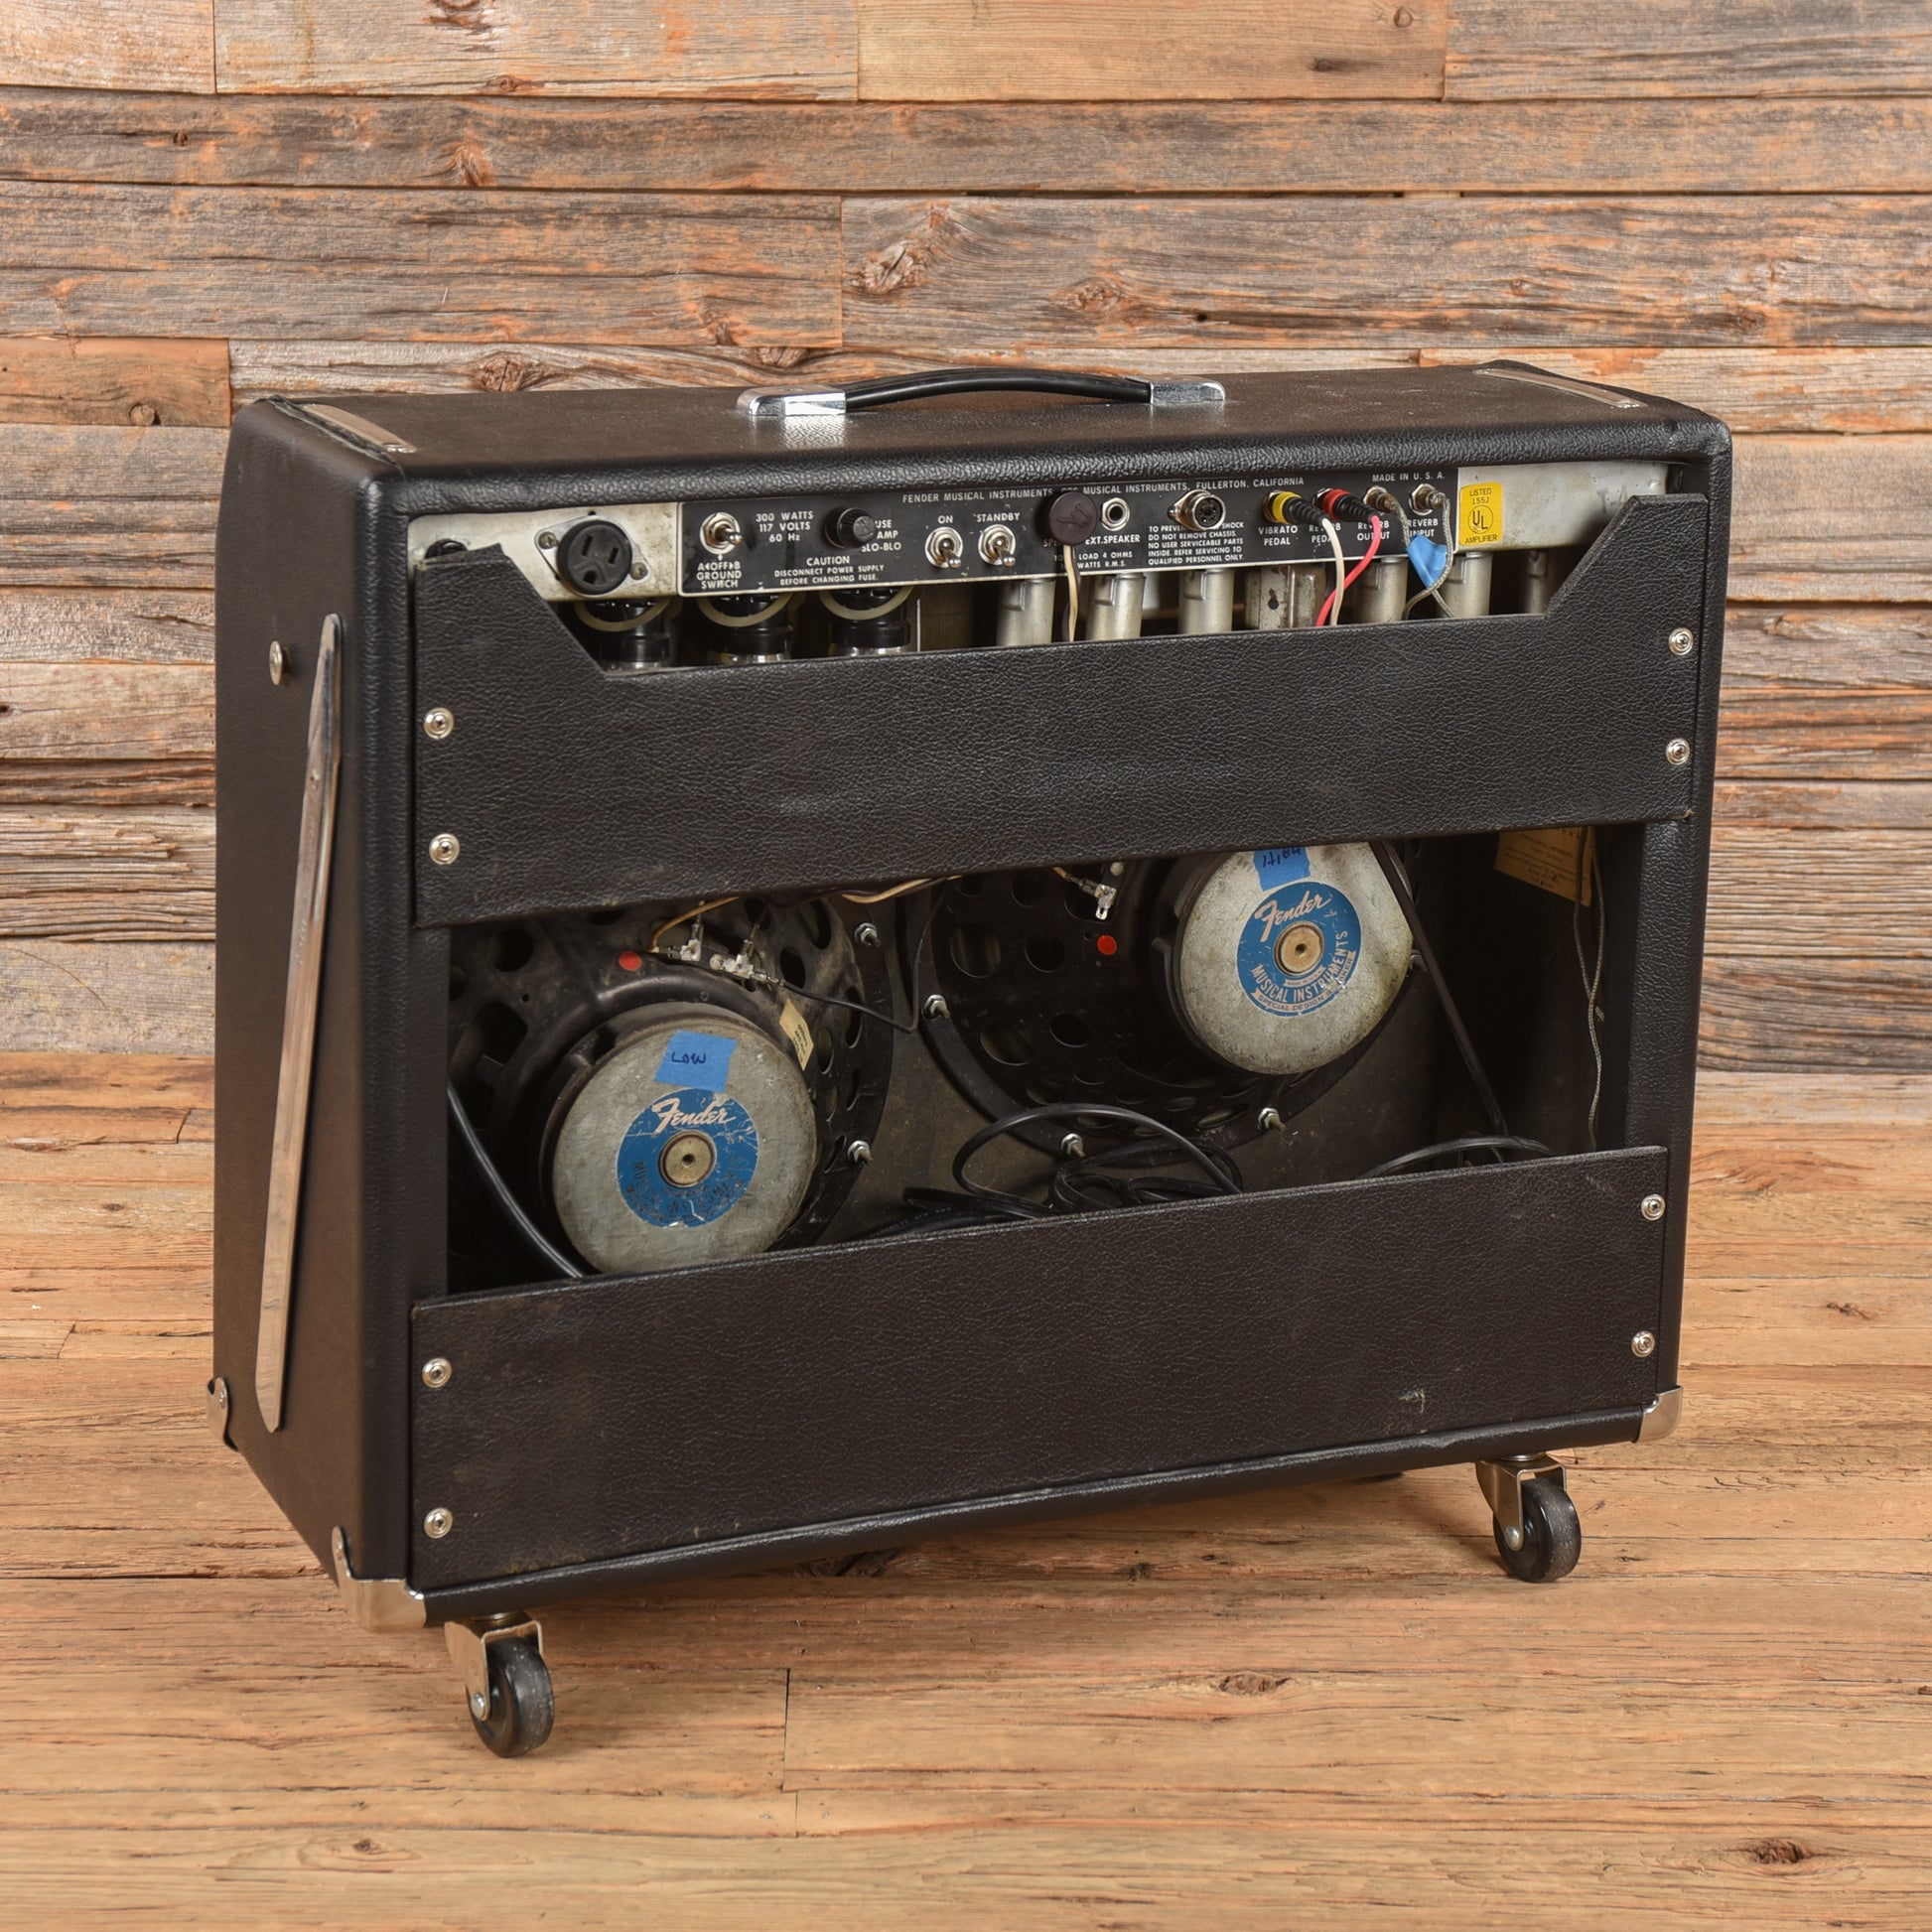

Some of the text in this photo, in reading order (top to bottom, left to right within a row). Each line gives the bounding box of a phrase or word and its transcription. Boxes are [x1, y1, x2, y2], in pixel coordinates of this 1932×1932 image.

[1372, 474, 1395, 483] MADE
[1083, 484, 1122, 494] MUSICAL
[1253, 477, 1305, 487] CALIFORNIA
[902, 494, 939, 503] FENDER
[943, 492, 985, 501] MUSICAL
[989, 488, 1053, 499] INSTRUMENTS
[1469, 487, 1492, 496] LISTED
[756, 511, 814, 522] 300 WATTS
[937, 514, 953, 524] ON
[976, 512, 1021, 523] STANDBY
[1408, 517, 1439, 527] REVERB
[759, 521, 811, 532] 117 VOLTS
[875, 519, 892, 529] USE
[1258, 524, 1299, 535] VIBRATO
[768, 532, 800, 543] 60 Hz
[877, 530, 898, 539] AMP
[1356, 531, 1390, 541] OUTUT
[1464, 534, 1498, 544] AMPLIFIER
[1180, 539, 1221, 548] SERVICEABLE
[1263, 536, 1291, 546] PEDAL
[1079, 551, 1099, 560] LOAD
[1111, 550, 1133, 559] OHMS
[1148, 557, 1182, 566] QUALIFIED
[1185, 555, 1222, 564] PERSONNEL
[806, 555, 850, 567] CAUTION
[1077, 560, 1101, 569] WATTS
[696, 570, 743, 581] GROUND
[774, 568, 823, 578] DISCONNECT
[858, 564, 885, 573] SUPPLY
[701, 579, 739, 589] SWITCH
[779, 576, 809, 586] BEFORE
[812, 574, 855, 584] CHANGING
[1254, 891, 1333, 943] Fender
[1251, 963, 1289, 1003] MUSICAL
[1293, 930, 1348, 1004] INSTRUMENTS
[1257, 995, 1291, 1012] SPECIAL
[1293, 994, 1324, 1012] DESIGN
[671, 1052, 707, 1065] LOW
[650, 1096, 737, 1137] Fender
